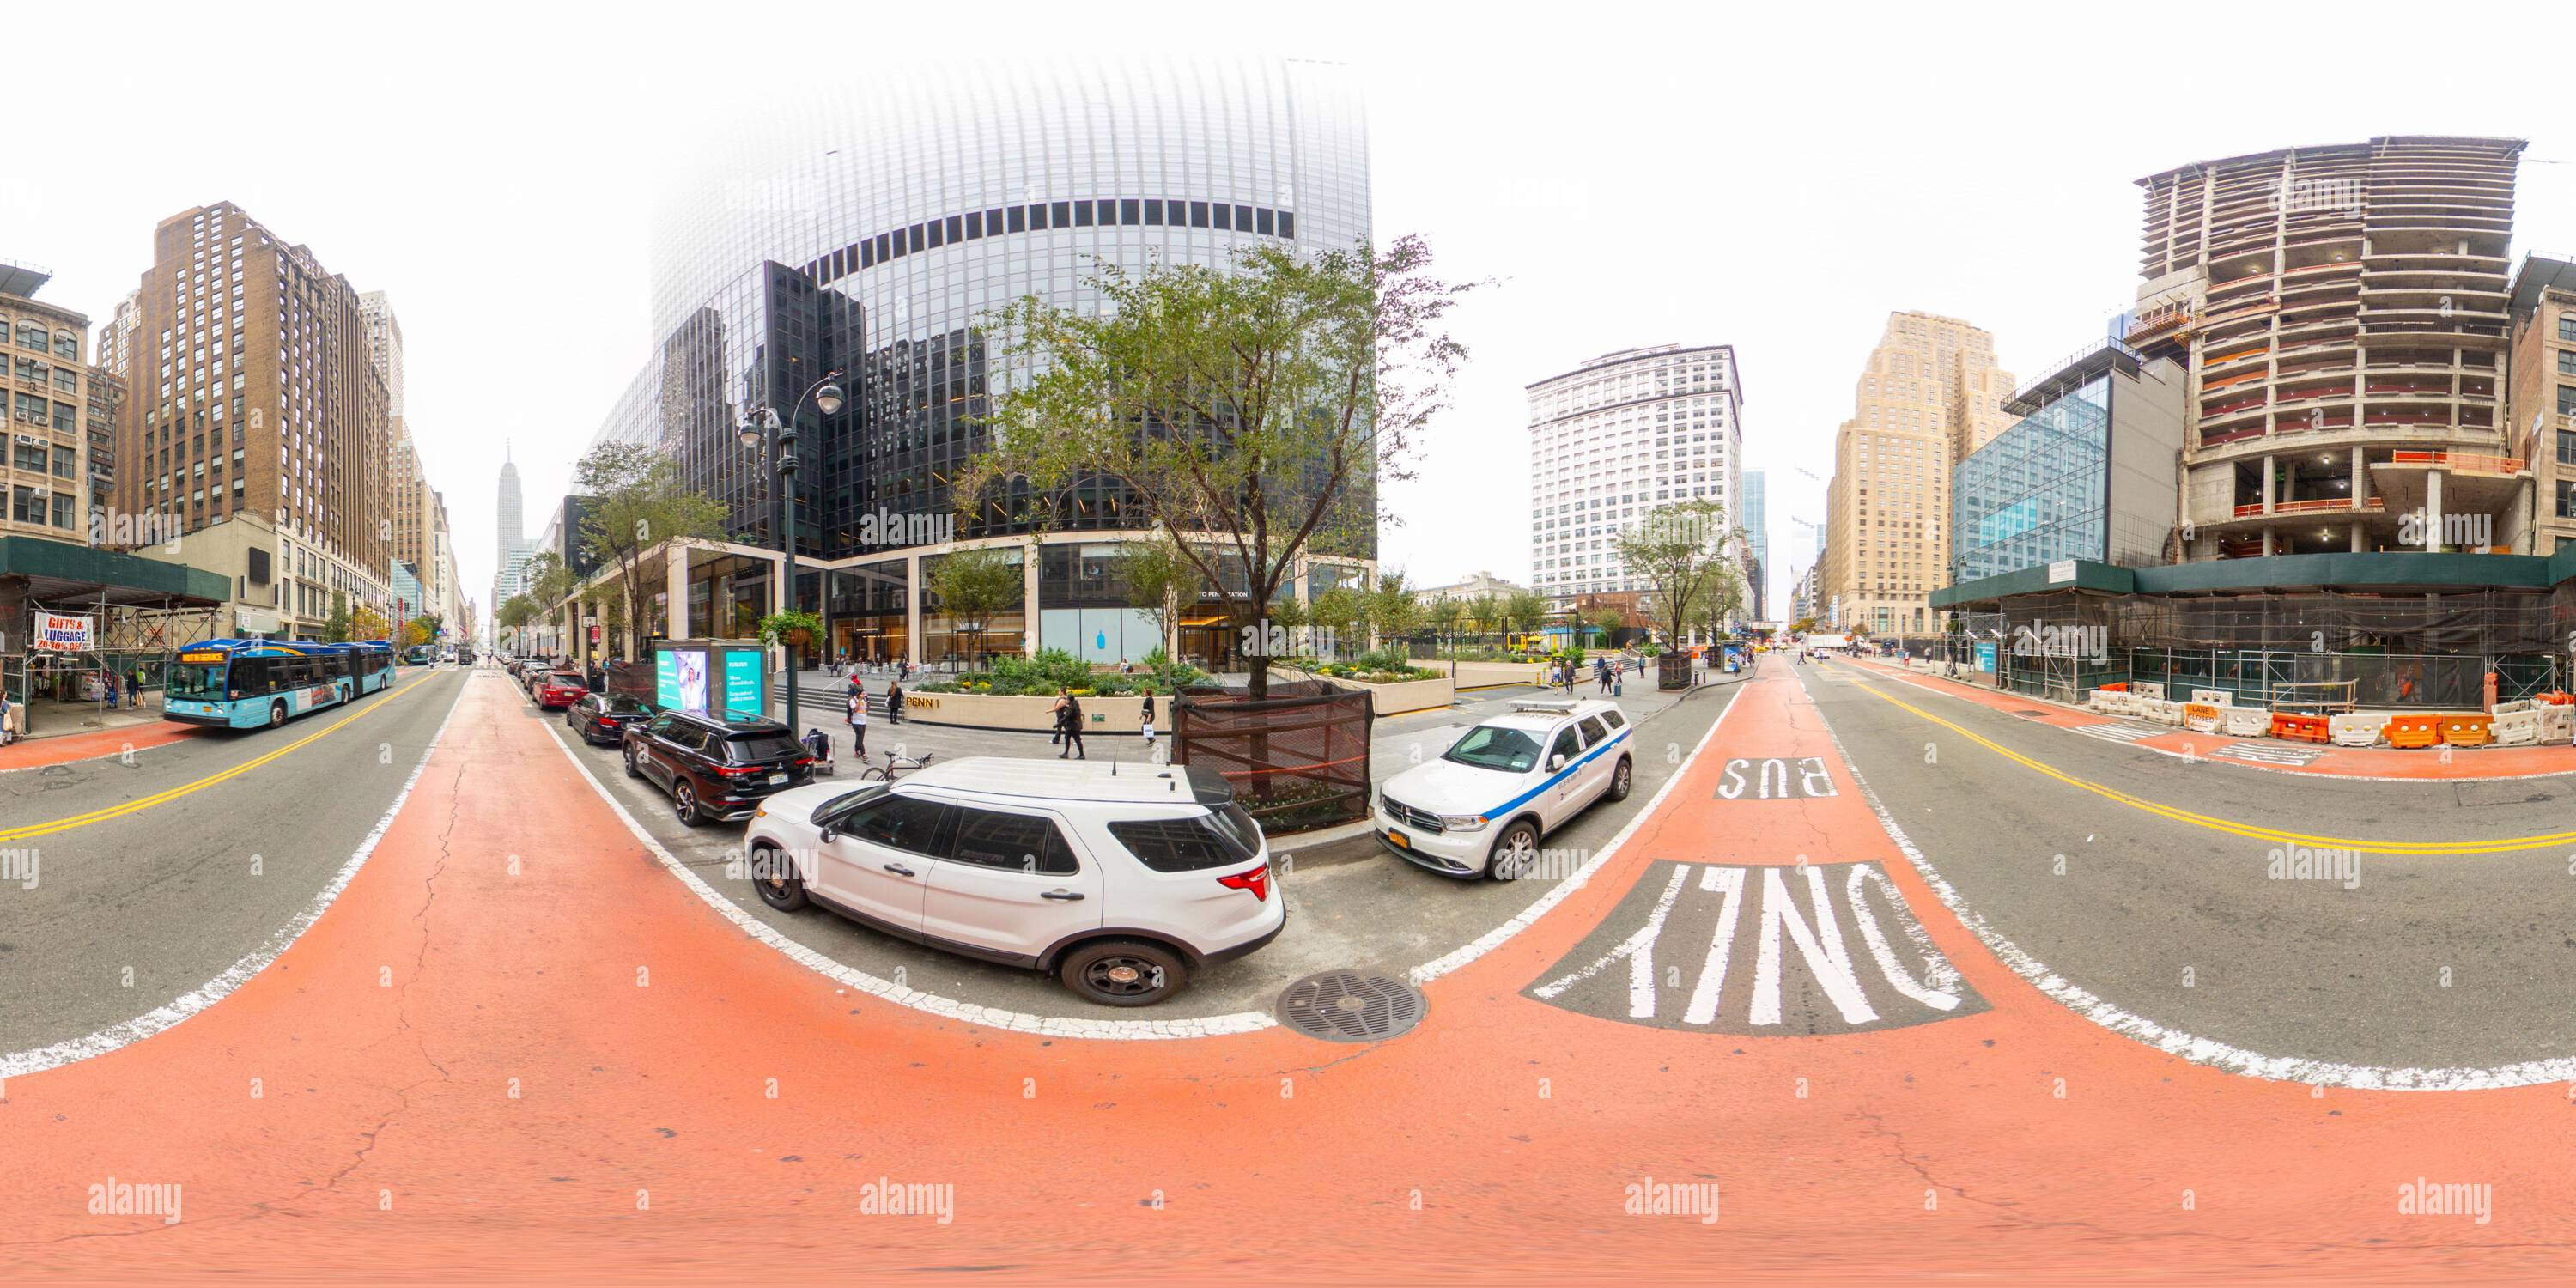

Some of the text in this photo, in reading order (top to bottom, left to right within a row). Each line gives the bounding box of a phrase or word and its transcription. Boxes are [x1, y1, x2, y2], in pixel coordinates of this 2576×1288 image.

[48, 617, 83, 629] GIFTS &
[44, 629, 86, 641] LUGGAGE
[37, 639, 68, 650] 20-30%
[69, 641, 83, 651] OFF
[200, 653, 223, 661] SERVICE
[906, 696, 934, 708] PENN
[2192, 706, 2211, 714] LANE
[2188, 714, 2215, 723] CLOSED
[1719, 757, 1839, 799] BUS
[1534, 863, 1962, 1025] ONLY
